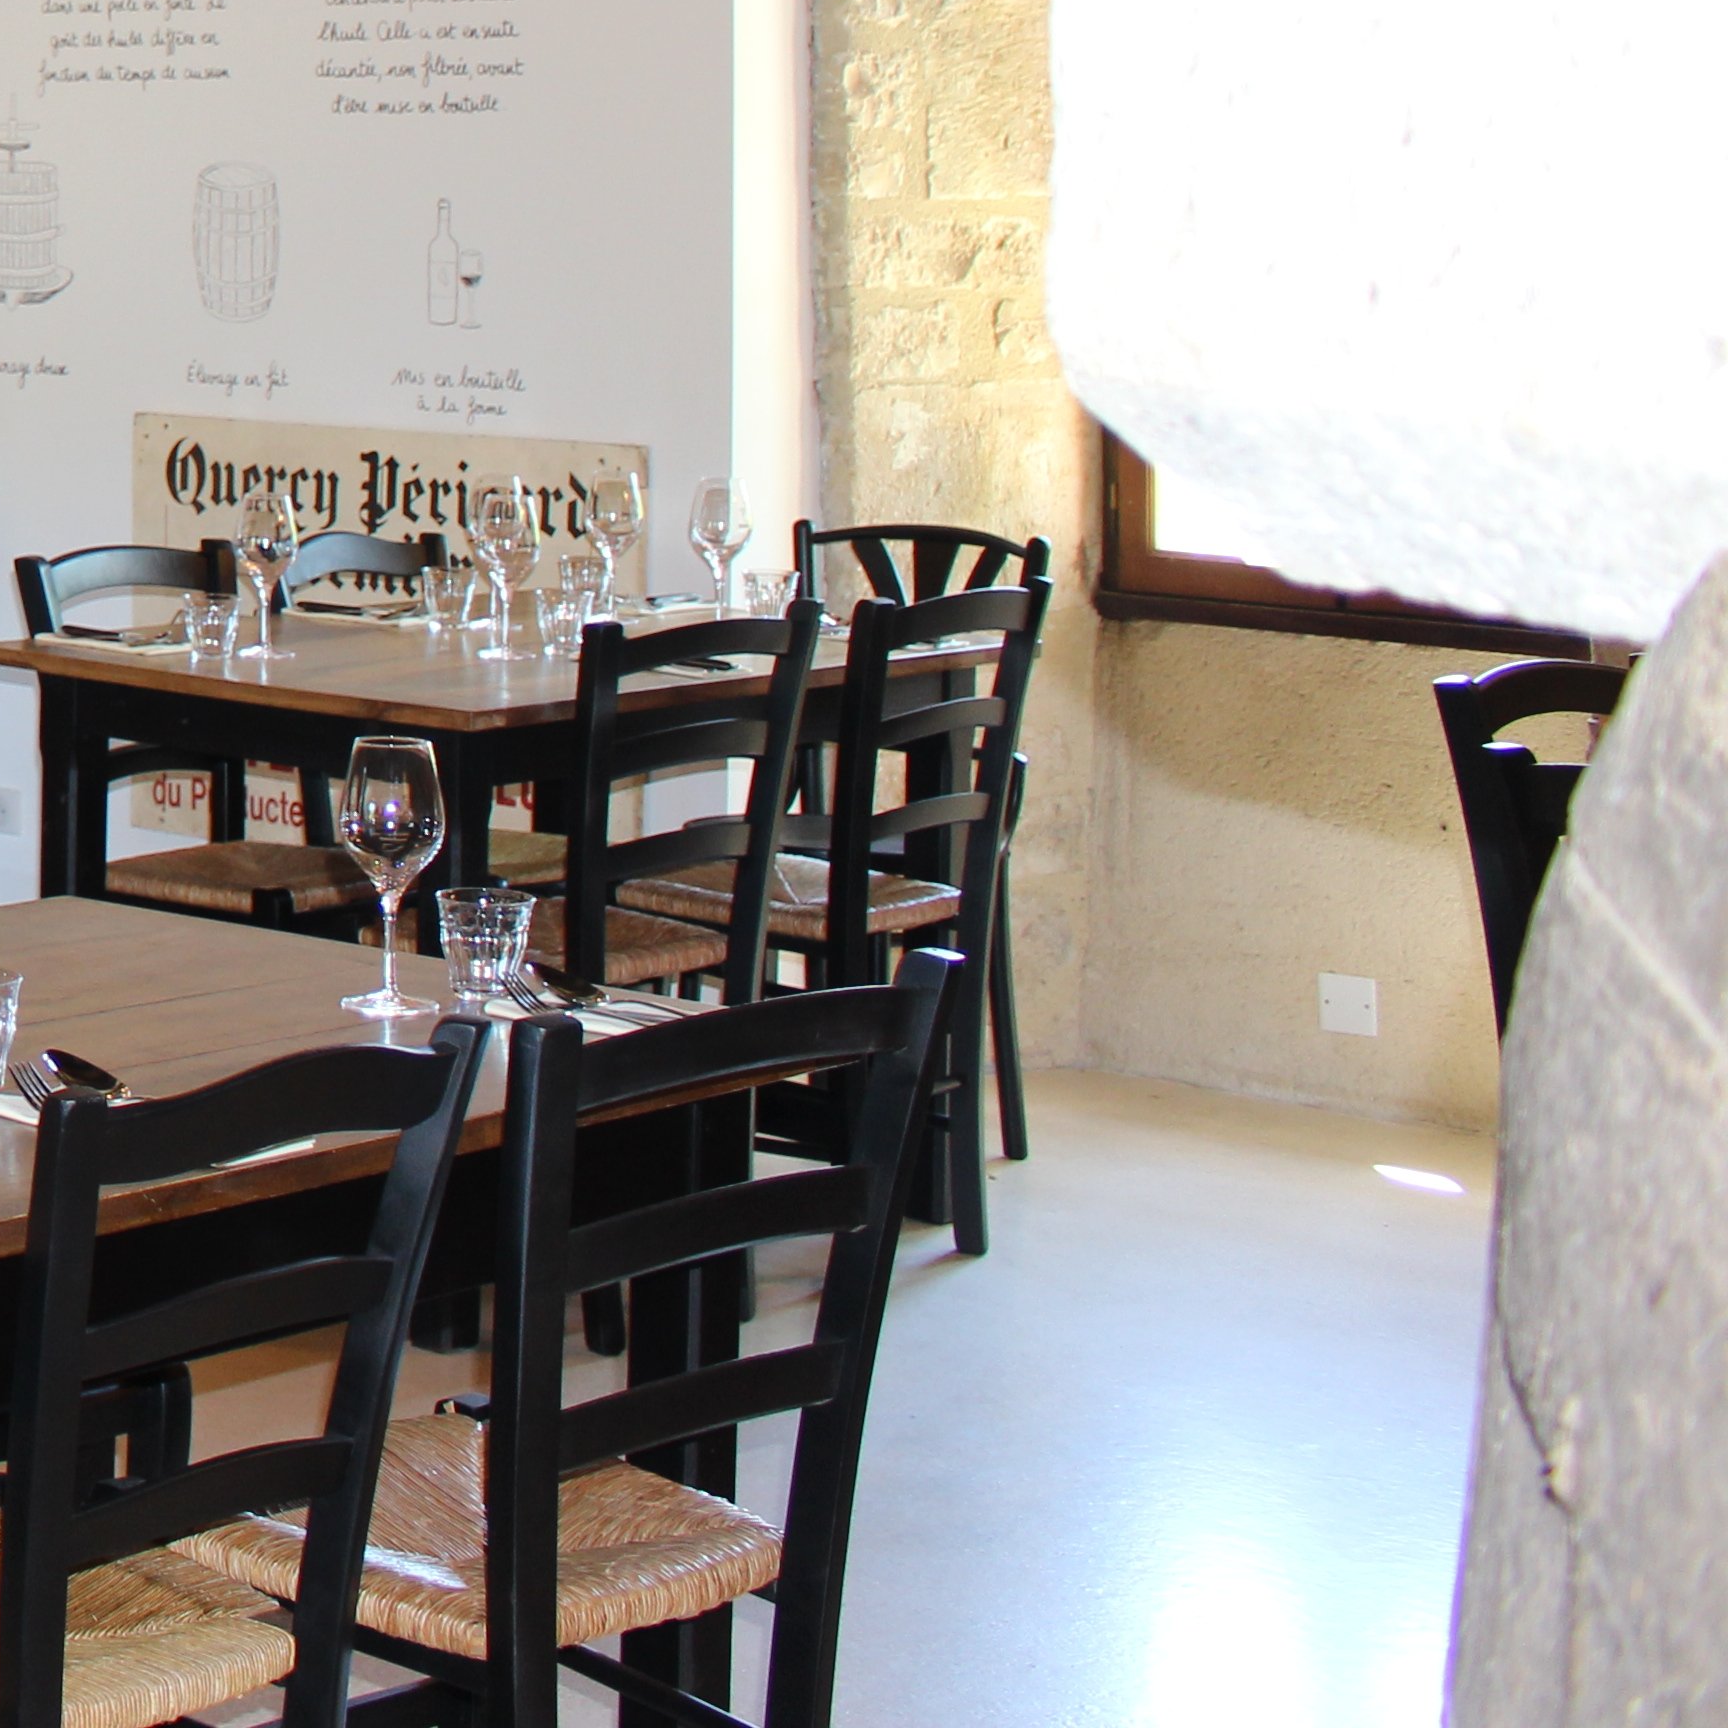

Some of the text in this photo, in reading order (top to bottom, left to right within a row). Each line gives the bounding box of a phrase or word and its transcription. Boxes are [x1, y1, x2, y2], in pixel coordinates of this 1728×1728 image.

[79, 1, 102, 14] une
[144, 0, 159, 11] en
[83, 31, 102, 47] des
[108, 29, 143, 48] huiles
[201, 32, 220, 46] en
[436, 24, 456, 40] est
[462, 20, 520, 39] ensuite
[37, 58, 90, 98] fonction
[96, 65, 113, 80] du
[116, 65, 156, 91] temps
[161, 65, 176, 79] de
[315, 58, 383, 84] décantée,
[385, 65, 417, 79] non
[477, 57, 525, 76] avant
[331, 93, 368, 114] d'être
[375, 100, 414, 114] mise
[418, 100, 435, 113] en
[34, 354, 70, 376] doux
[244, 374, 262, 387] en
[390, 364, 526, 392] Mis en bouteille
[416, 395, 430, 412] à
[436, 395, 459, 413] la
[166, 436, 339, 532] Quercy
[152, 772, 181, 808] du
